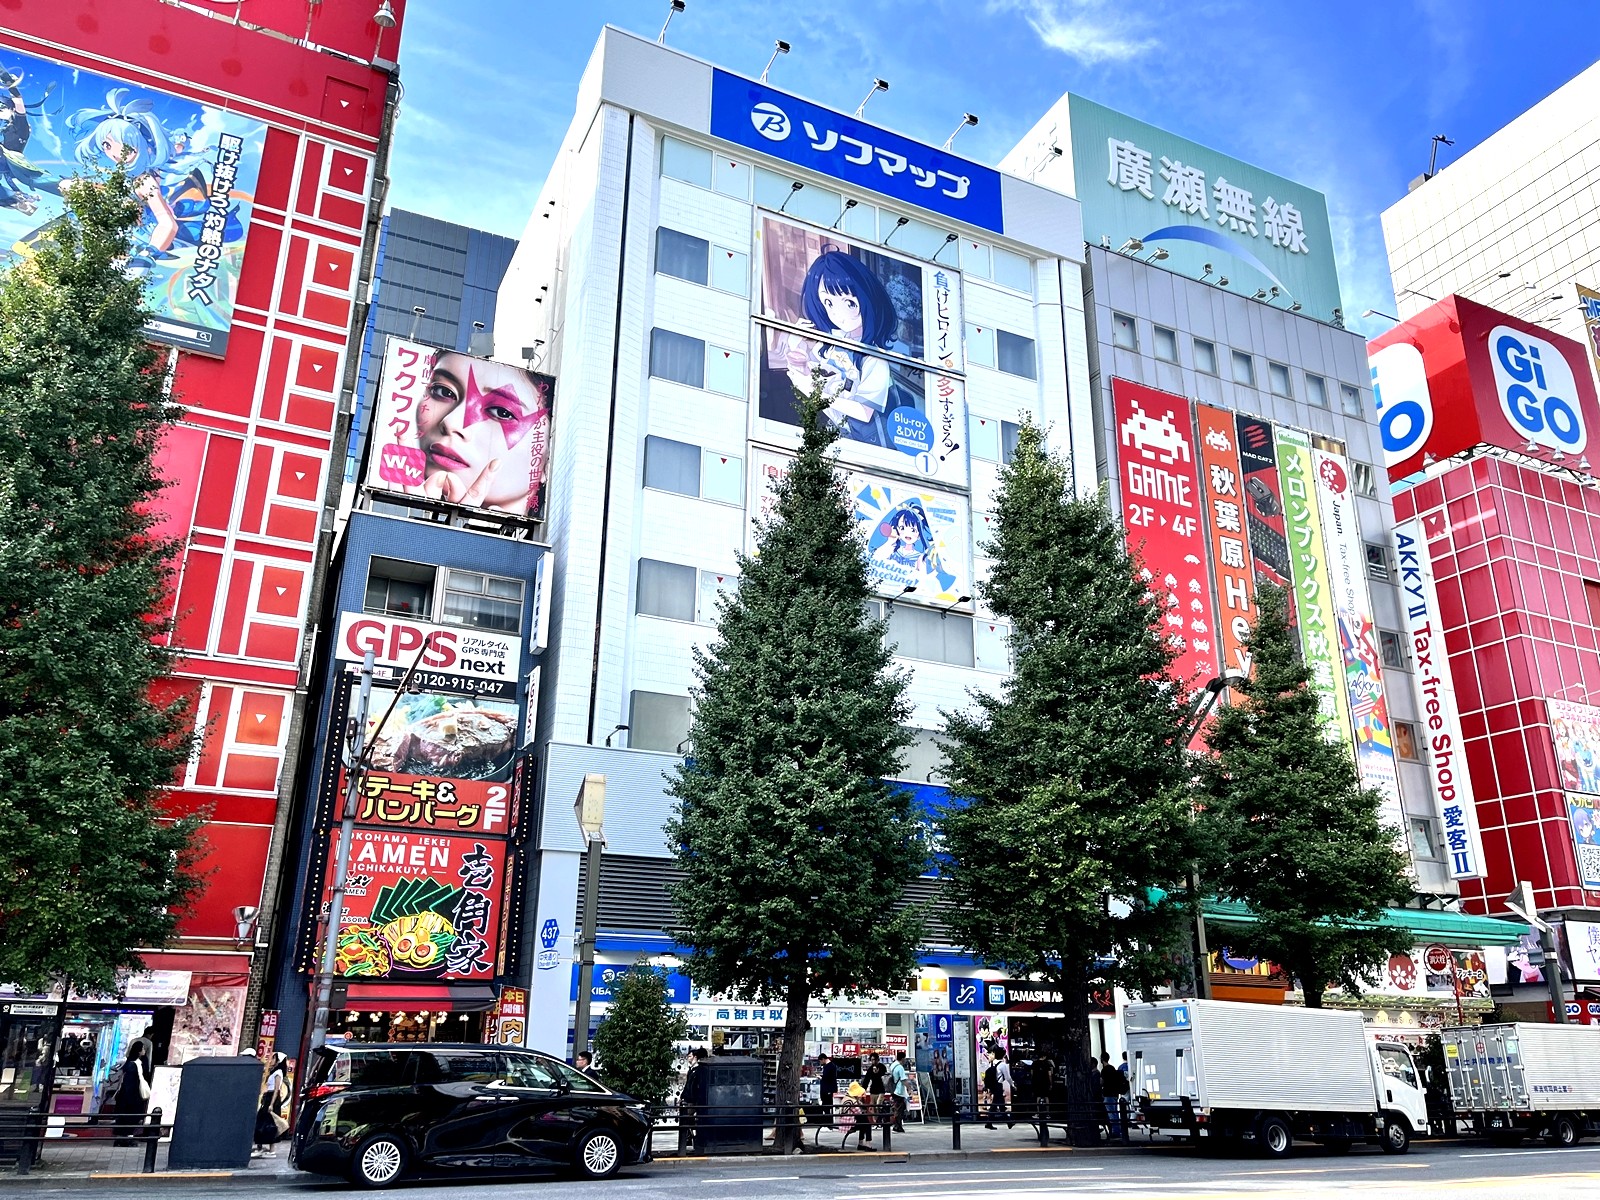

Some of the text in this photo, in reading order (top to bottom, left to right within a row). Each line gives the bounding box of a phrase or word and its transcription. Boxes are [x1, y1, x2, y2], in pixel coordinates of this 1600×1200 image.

[803, 121, 971, 199] ソフマップ
[1107, 137, 1309, 255] 廣瀬無線
[188, 132, 243, 306] 駆け抜けろ、灼熱のナタへ
[388, 347, 419, 438] ワクワク
[894, 412, 927, 431] Blu-ray
[896, 425, 926, 441] &DVD
[1127, 461, 1193, 508] GAME
[1128, 504, 1197, 538] 2F 4F
[346, 620, 458, 668] GPS
[462, 637, 509, 650] リアルタイム
[460, 656, 506, 675] next
[1396, 532, 1425, 600] AKKY
[1413, 621, 1443, 730] Tax-free
[1432, 734, 1456, 802] Shop
[413, 673, 504, 694] 0120-915-047
[361, 798, 481, 827] ハンバーグ
[419, 837, 450, 847] IEKEI
[353, 863, 428, 875] ICHIKAKUYA
[541, 926, 558, 939] 437
[504, 991, 525, 1003] 本日
